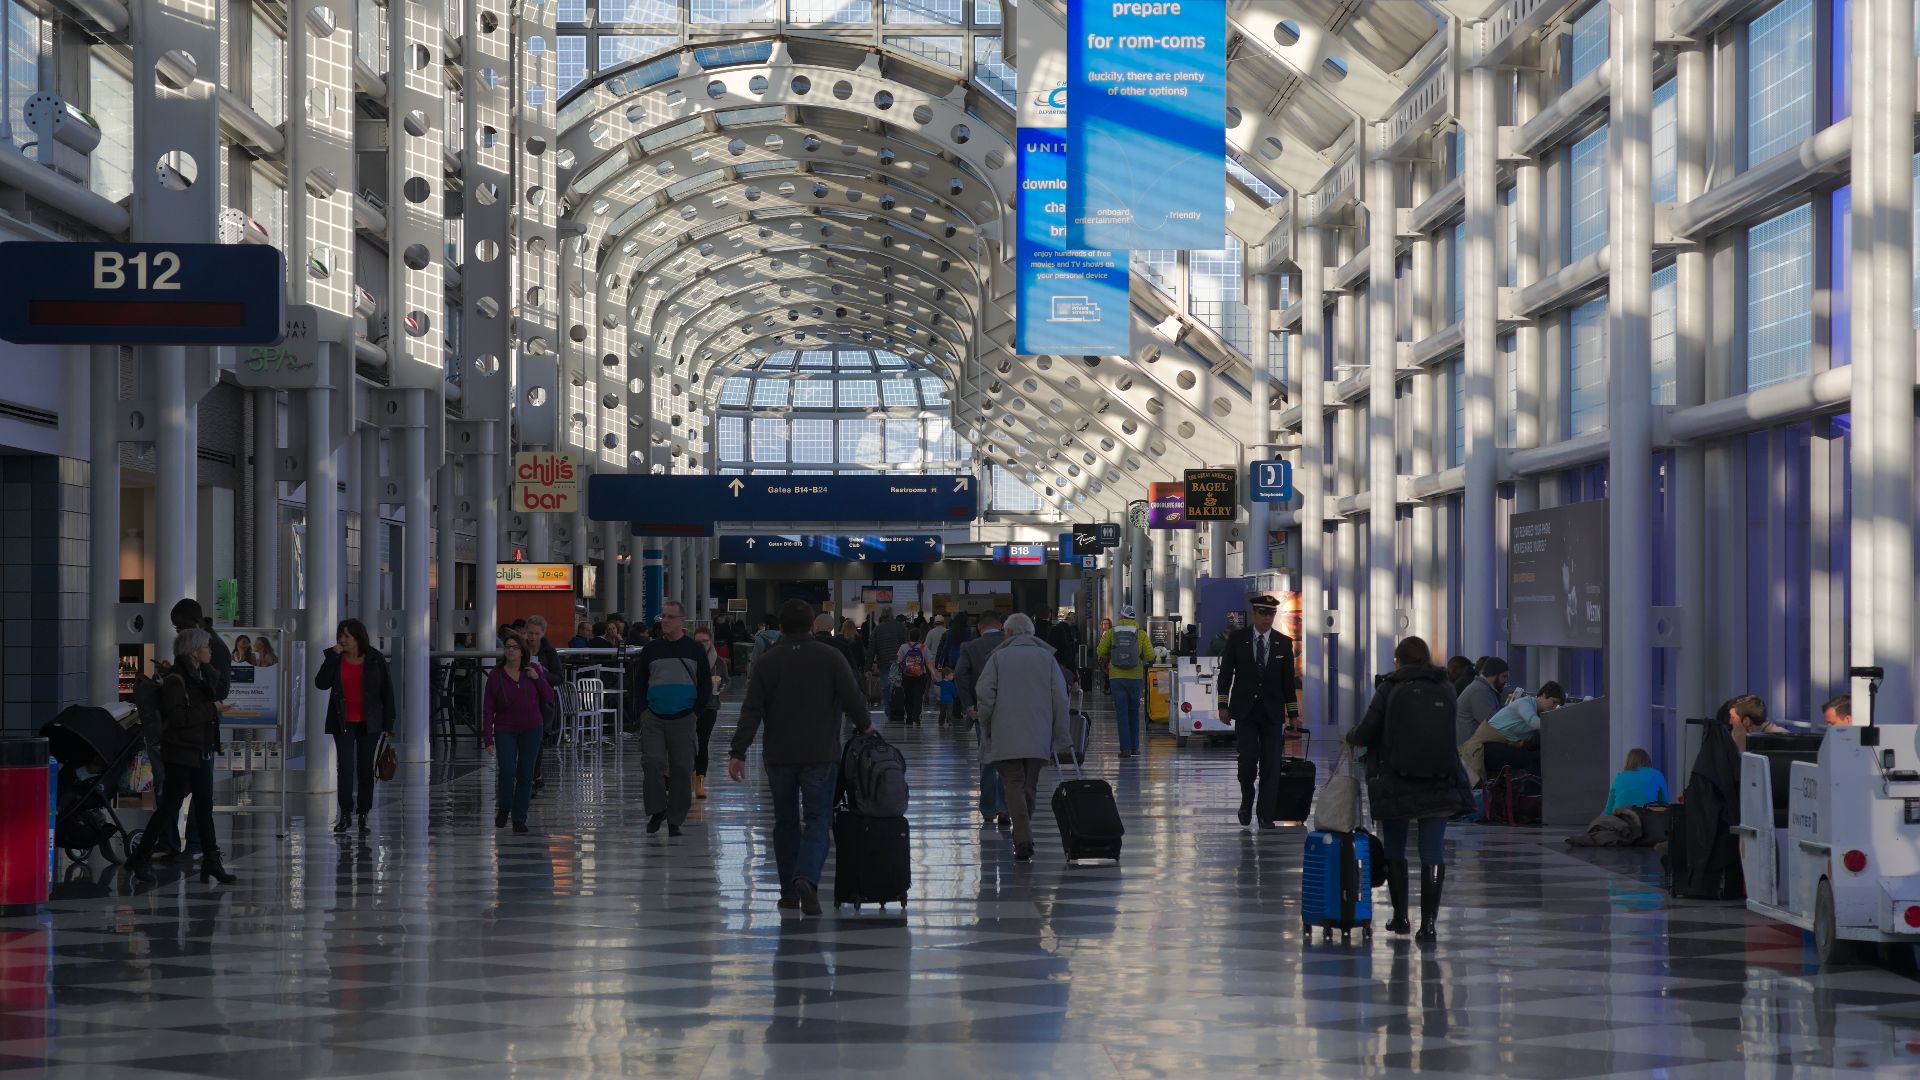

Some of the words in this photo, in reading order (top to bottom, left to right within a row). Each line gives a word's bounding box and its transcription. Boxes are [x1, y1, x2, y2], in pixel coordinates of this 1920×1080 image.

[1112, 0, 1181, 18] prepare
[1087, 33, 1112, 49] for
[1118, 34, 1206, 49] rom-coms
[1088, 71, 1124, 83] (luckily,
[1127, 71, 1150, 82] there
[1153, 73, 1171, 82] are
[1174, 71, 1205, 84] plenty
[1107, 86, 1119, 96] of
[1120, 86, 1145, 96] other
[1148, 86, 1188, 98] options)
[1097, 207, 1131, 216] onboard
[1169, 211, 1201, 221] friendly
[1074, 216, 1131, 225] entertainment
[93, 251, 181, 290] B12
[1054, 272, 1085, 280] personal
[767, 486, 792, 494] Gates
[1191, 482, 1229, 492] BAGEL
[523, 485, 567, 510] bar
[1188, 506, 1232, 516] BAKERY
[1010, 546, 1030, 555] B18
[889, 564, 905, 572] B17
